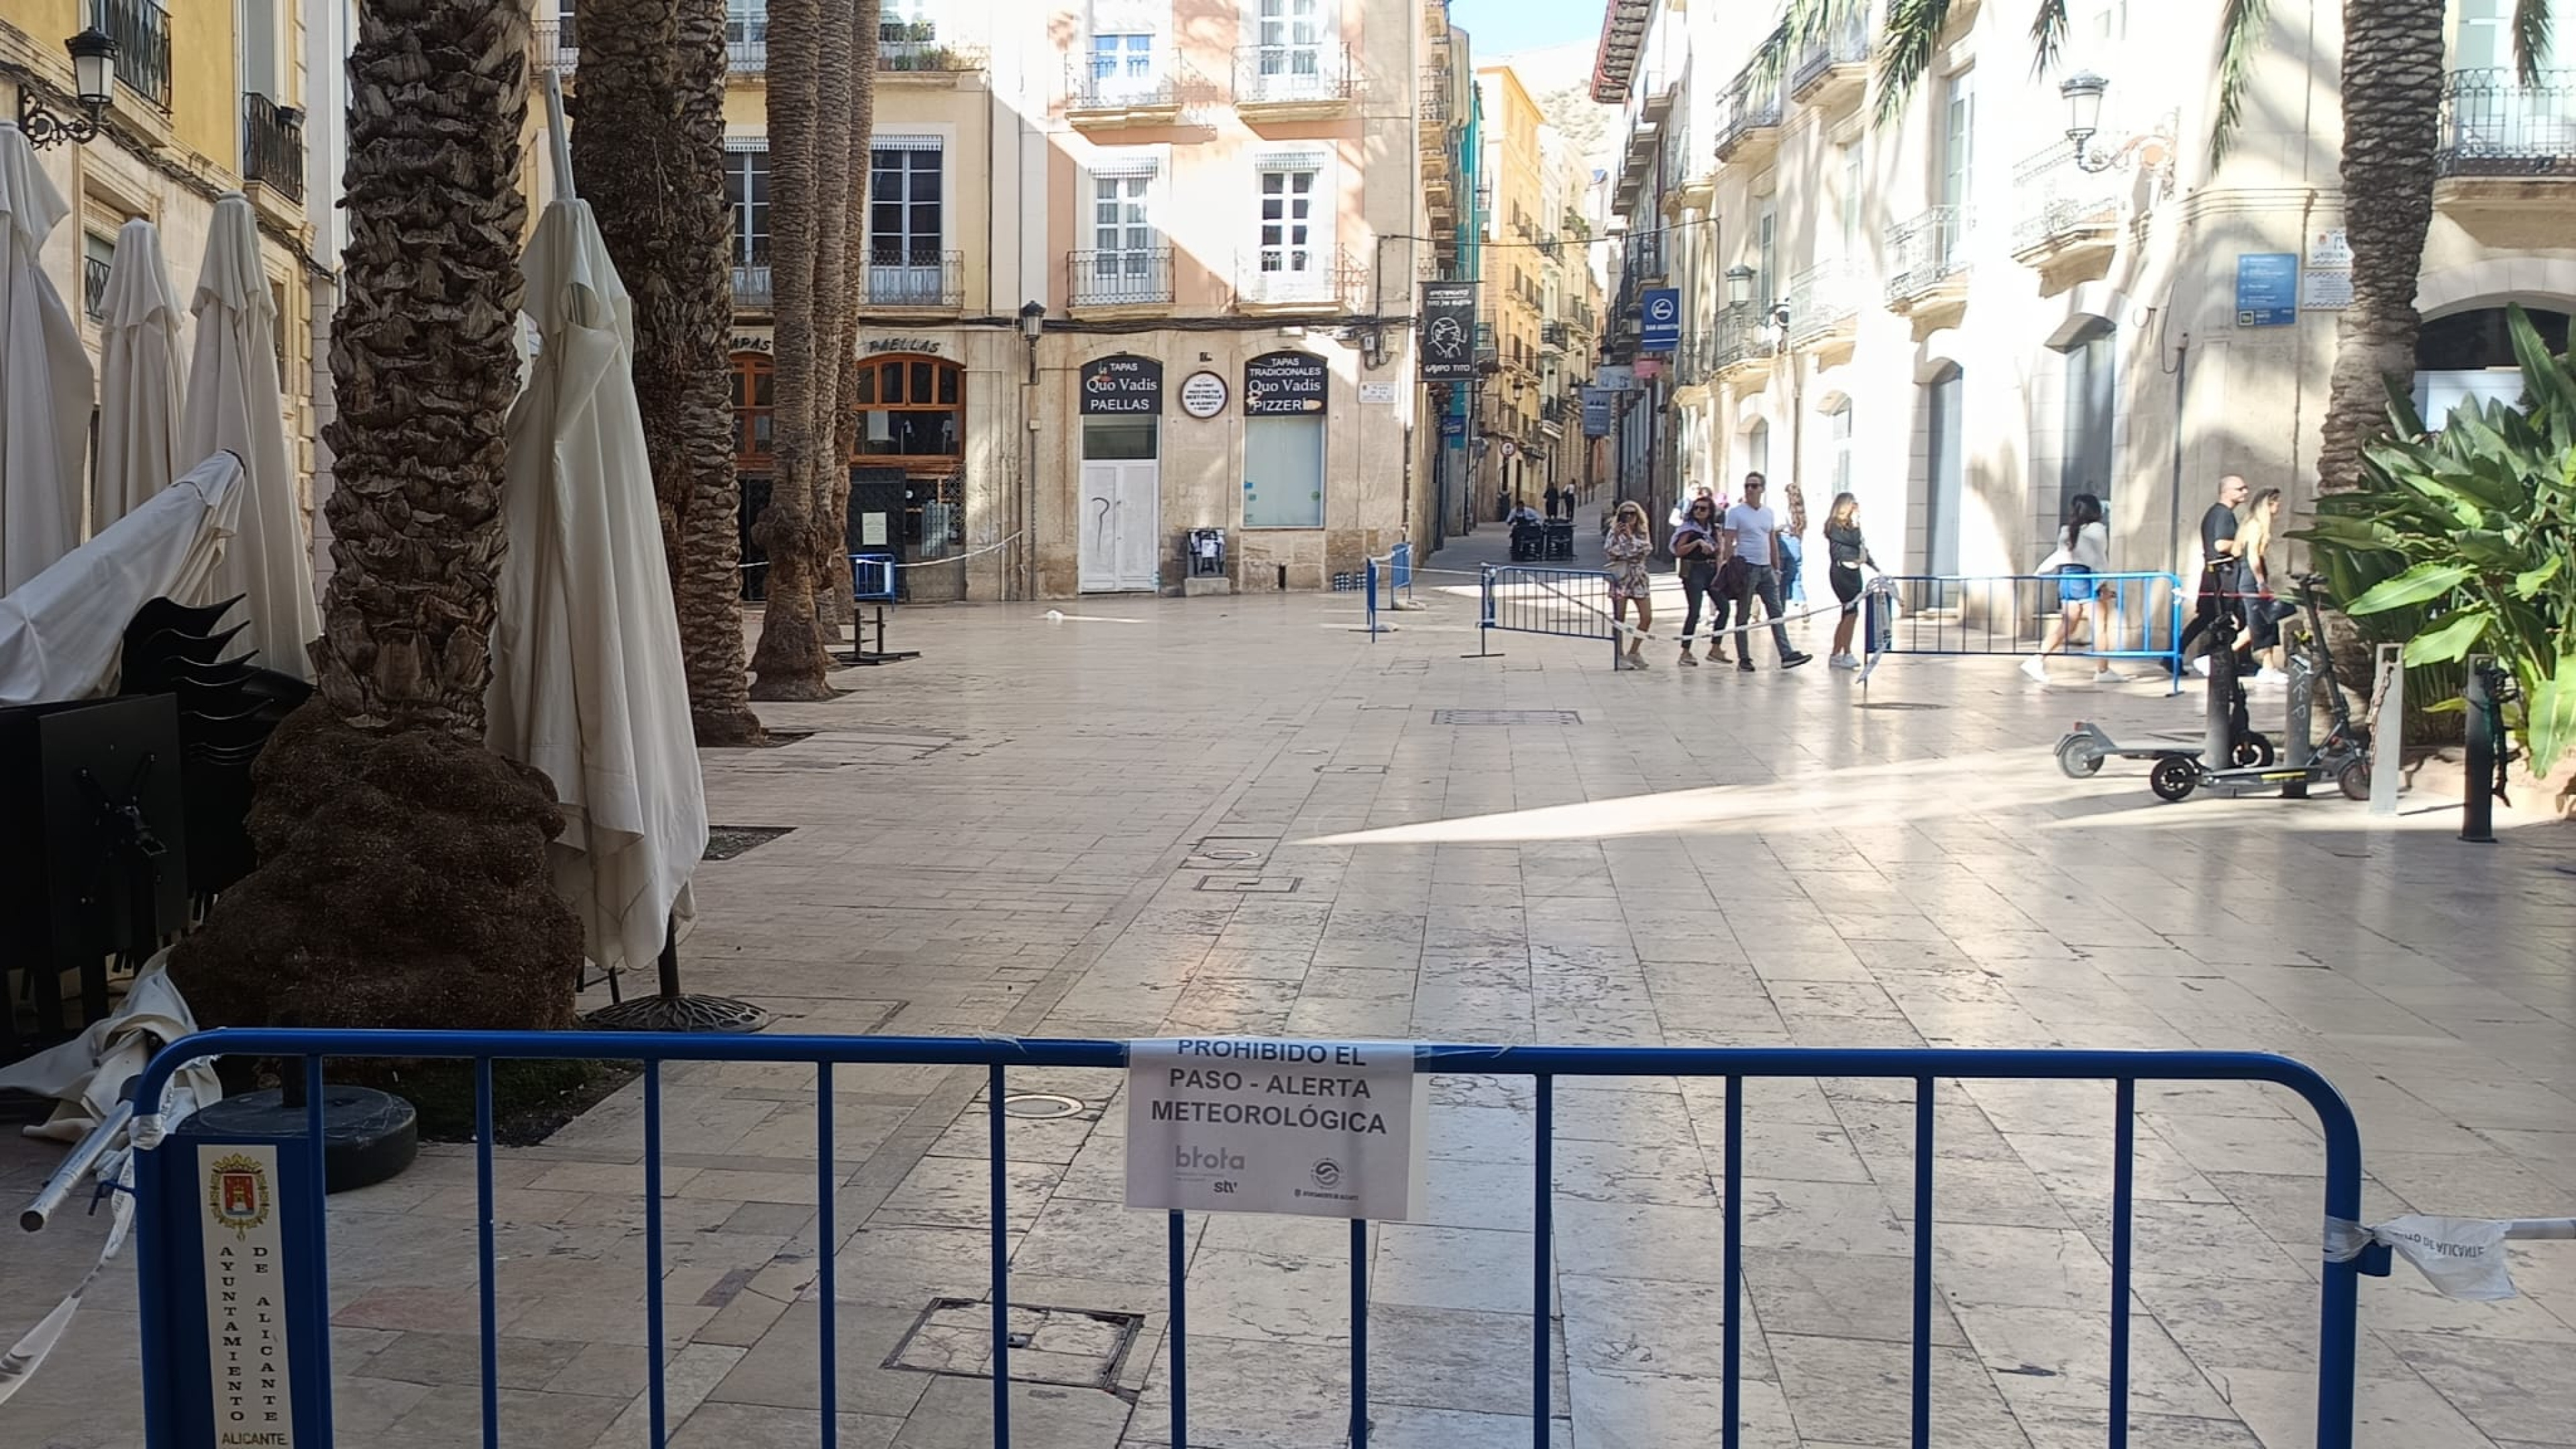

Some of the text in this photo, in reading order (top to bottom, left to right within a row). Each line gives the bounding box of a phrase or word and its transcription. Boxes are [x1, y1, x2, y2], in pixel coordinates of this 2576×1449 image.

[728, 335, 772, 352] APAS
[869, 337, 941, 353] PAELLAS
[1109, 363, 1138, 371] TAPAS
[1270, 358, 1299, 366] TAPAS
[1248, 366, 1322, 376] TRADICIONALES
[1087, 376, 1158, 393] Quo Vadis
[1248, 378, 1322, 392] Quo Vadis
[1090, 398, 1150, 411] PAELLAS
[1177, 1039, 1367, 1067] PROHIBIDO EL
[1169, 1068, 1242, 1091] PASO
[1266, 1074, 1371, 1099] ALERTA
[1152, 1099, 1387, 1134] METEOROLÓGICA
[1175, 1145, 1246, 1170] brota
[220, 1246, 244, 1421] AYUNTAMIENTO
[252, 1246, 278, 1421] DE ALICANTE
[221, 1432, 288, 1446] ALICANTE
